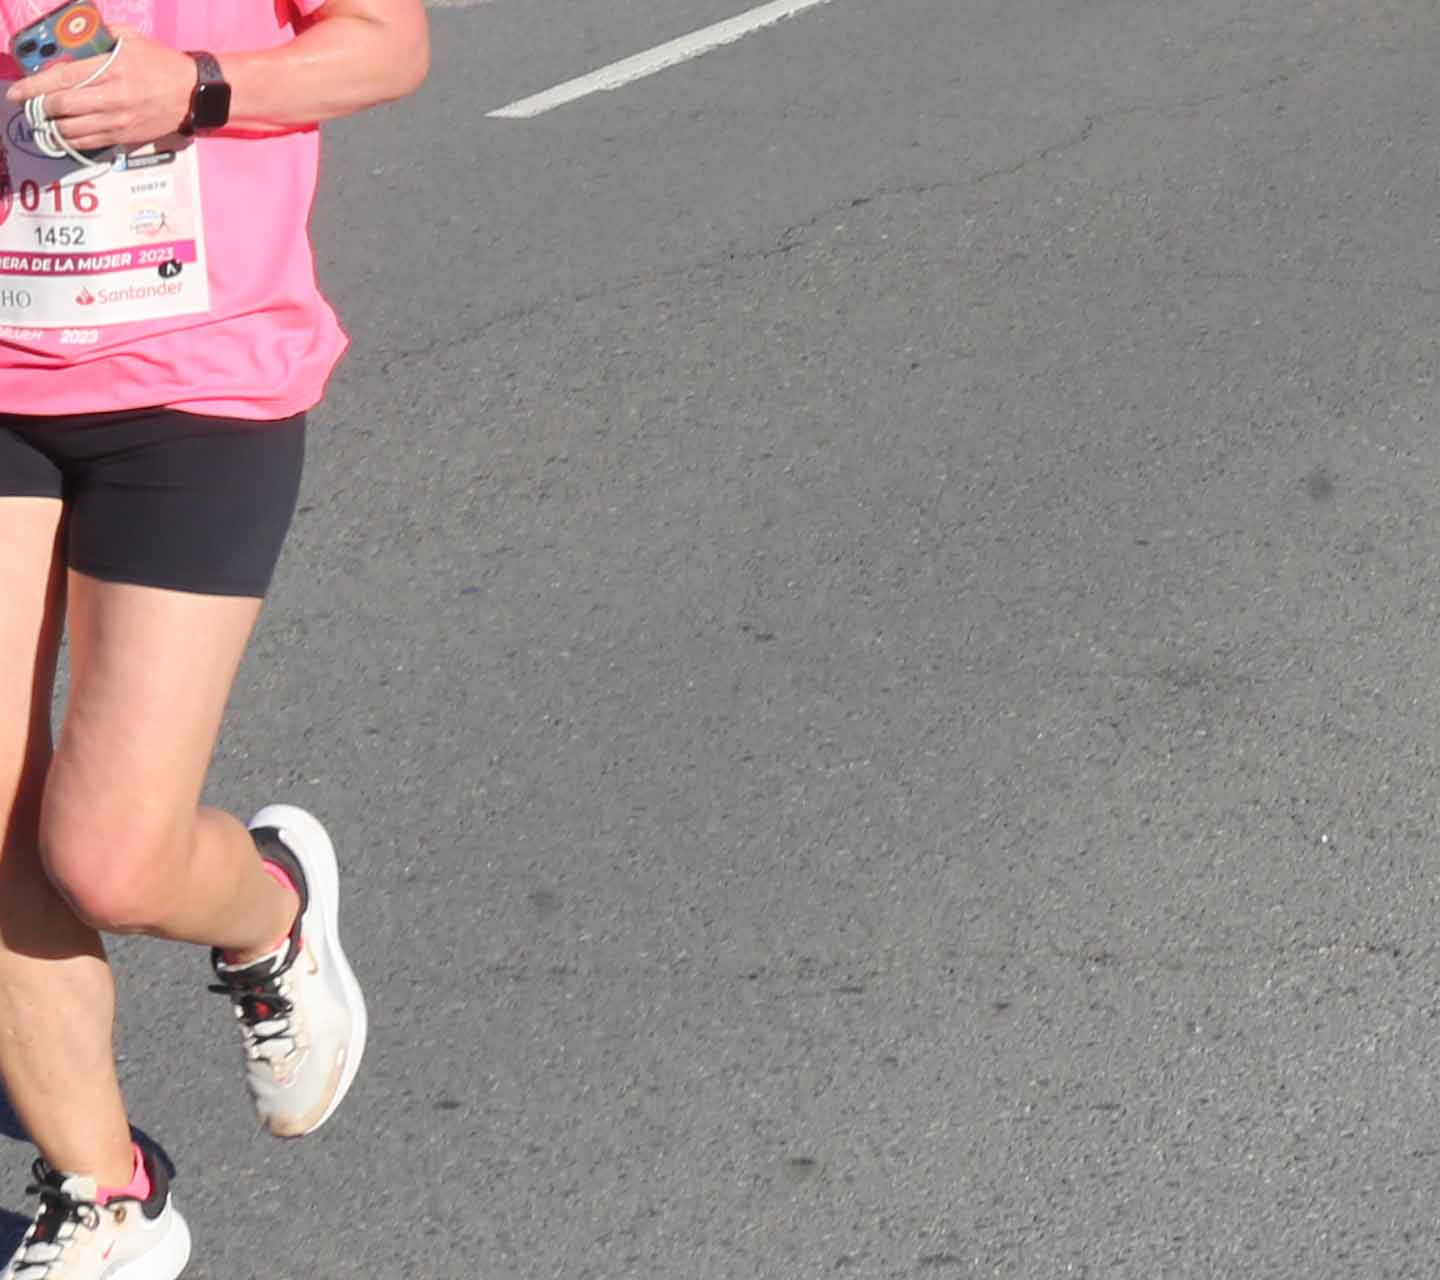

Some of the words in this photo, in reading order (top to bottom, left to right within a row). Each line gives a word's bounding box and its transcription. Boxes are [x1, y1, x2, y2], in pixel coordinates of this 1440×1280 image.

[19, 179, 100, 213] 016
[33, 225, 86, 247] 1452
[31, 257, 51, 273] DE
[54, 256, 75, 273] LA
[77, 252, 133, 272] MUJER
[137, 246, 176, 264] 2023
[96, 281, 184, 306] Santander
